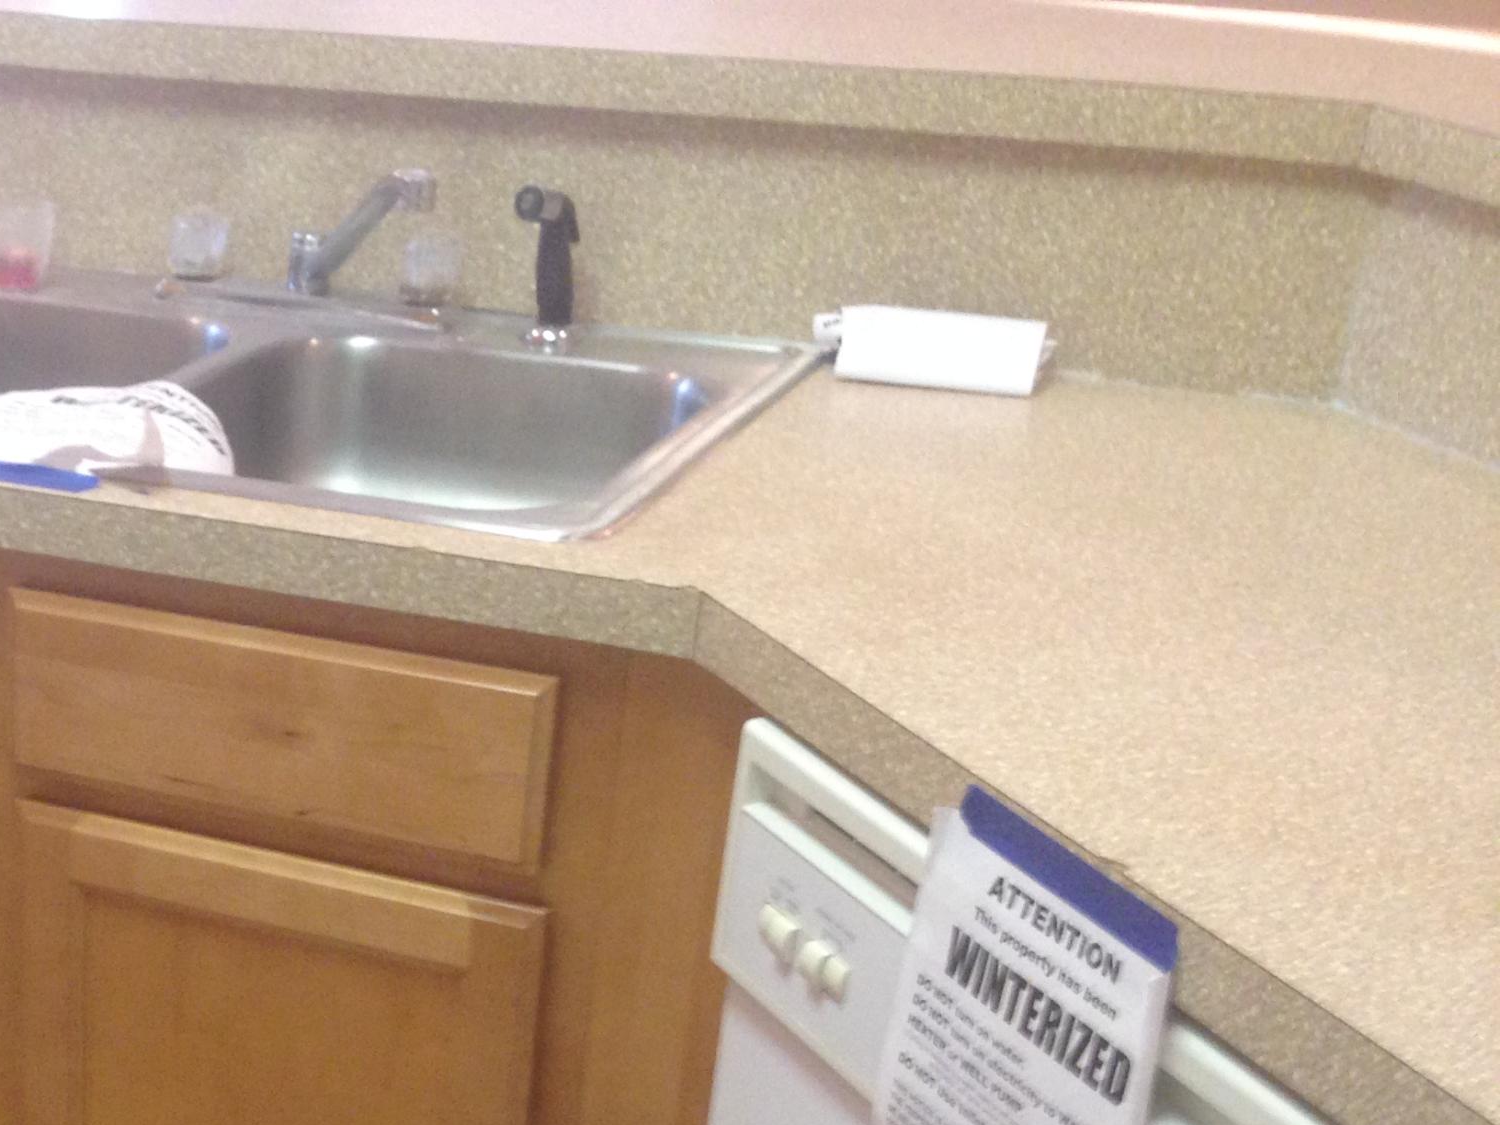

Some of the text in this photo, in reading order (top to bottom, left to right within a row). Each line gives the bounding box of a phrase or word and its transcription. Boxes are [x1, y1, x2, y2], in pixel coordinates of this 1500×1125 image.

[975, 906, 1117, 1020] This property has been
[988, 877, 1123, 984] ATTENTION
[945, 923, 1131, 1107] WINTERIZED
